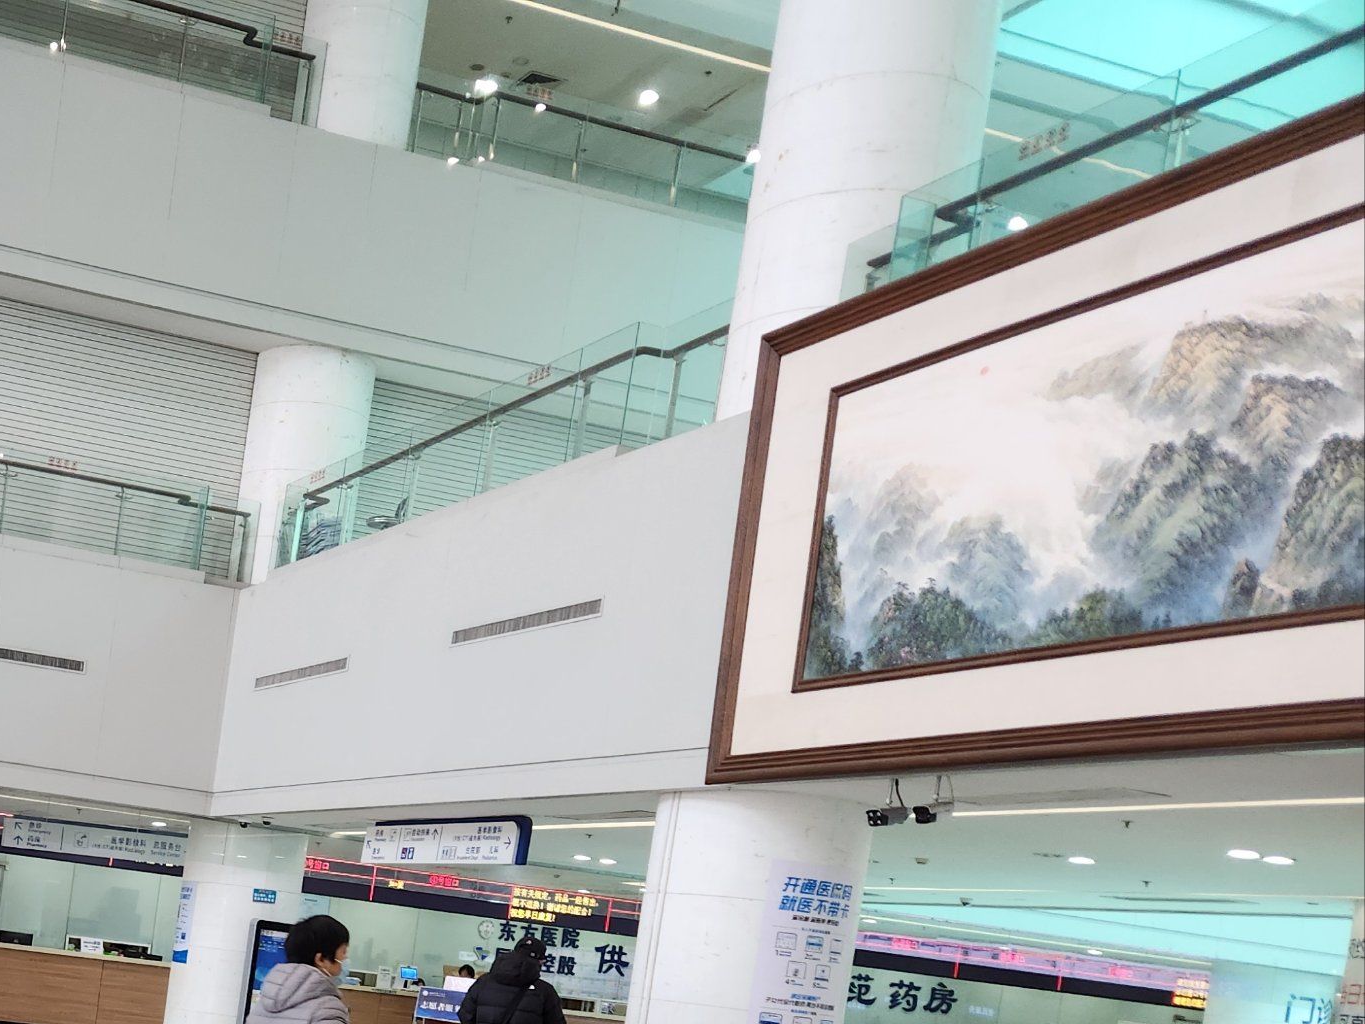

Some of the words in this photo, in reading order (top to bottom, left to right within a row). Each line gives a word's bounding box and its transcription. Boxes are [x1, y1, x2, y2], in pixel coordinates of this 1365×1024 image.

[26, 841, 47, 849] Pharmacy
[110, 836, 147, 847] 医学影像科
[778, 895, 850, 919] 就医不带卡
[498, 921, 580, 949] 东方医院
[496, 947, 577, 976] 控股
[595, 943, 630, 977] 供
